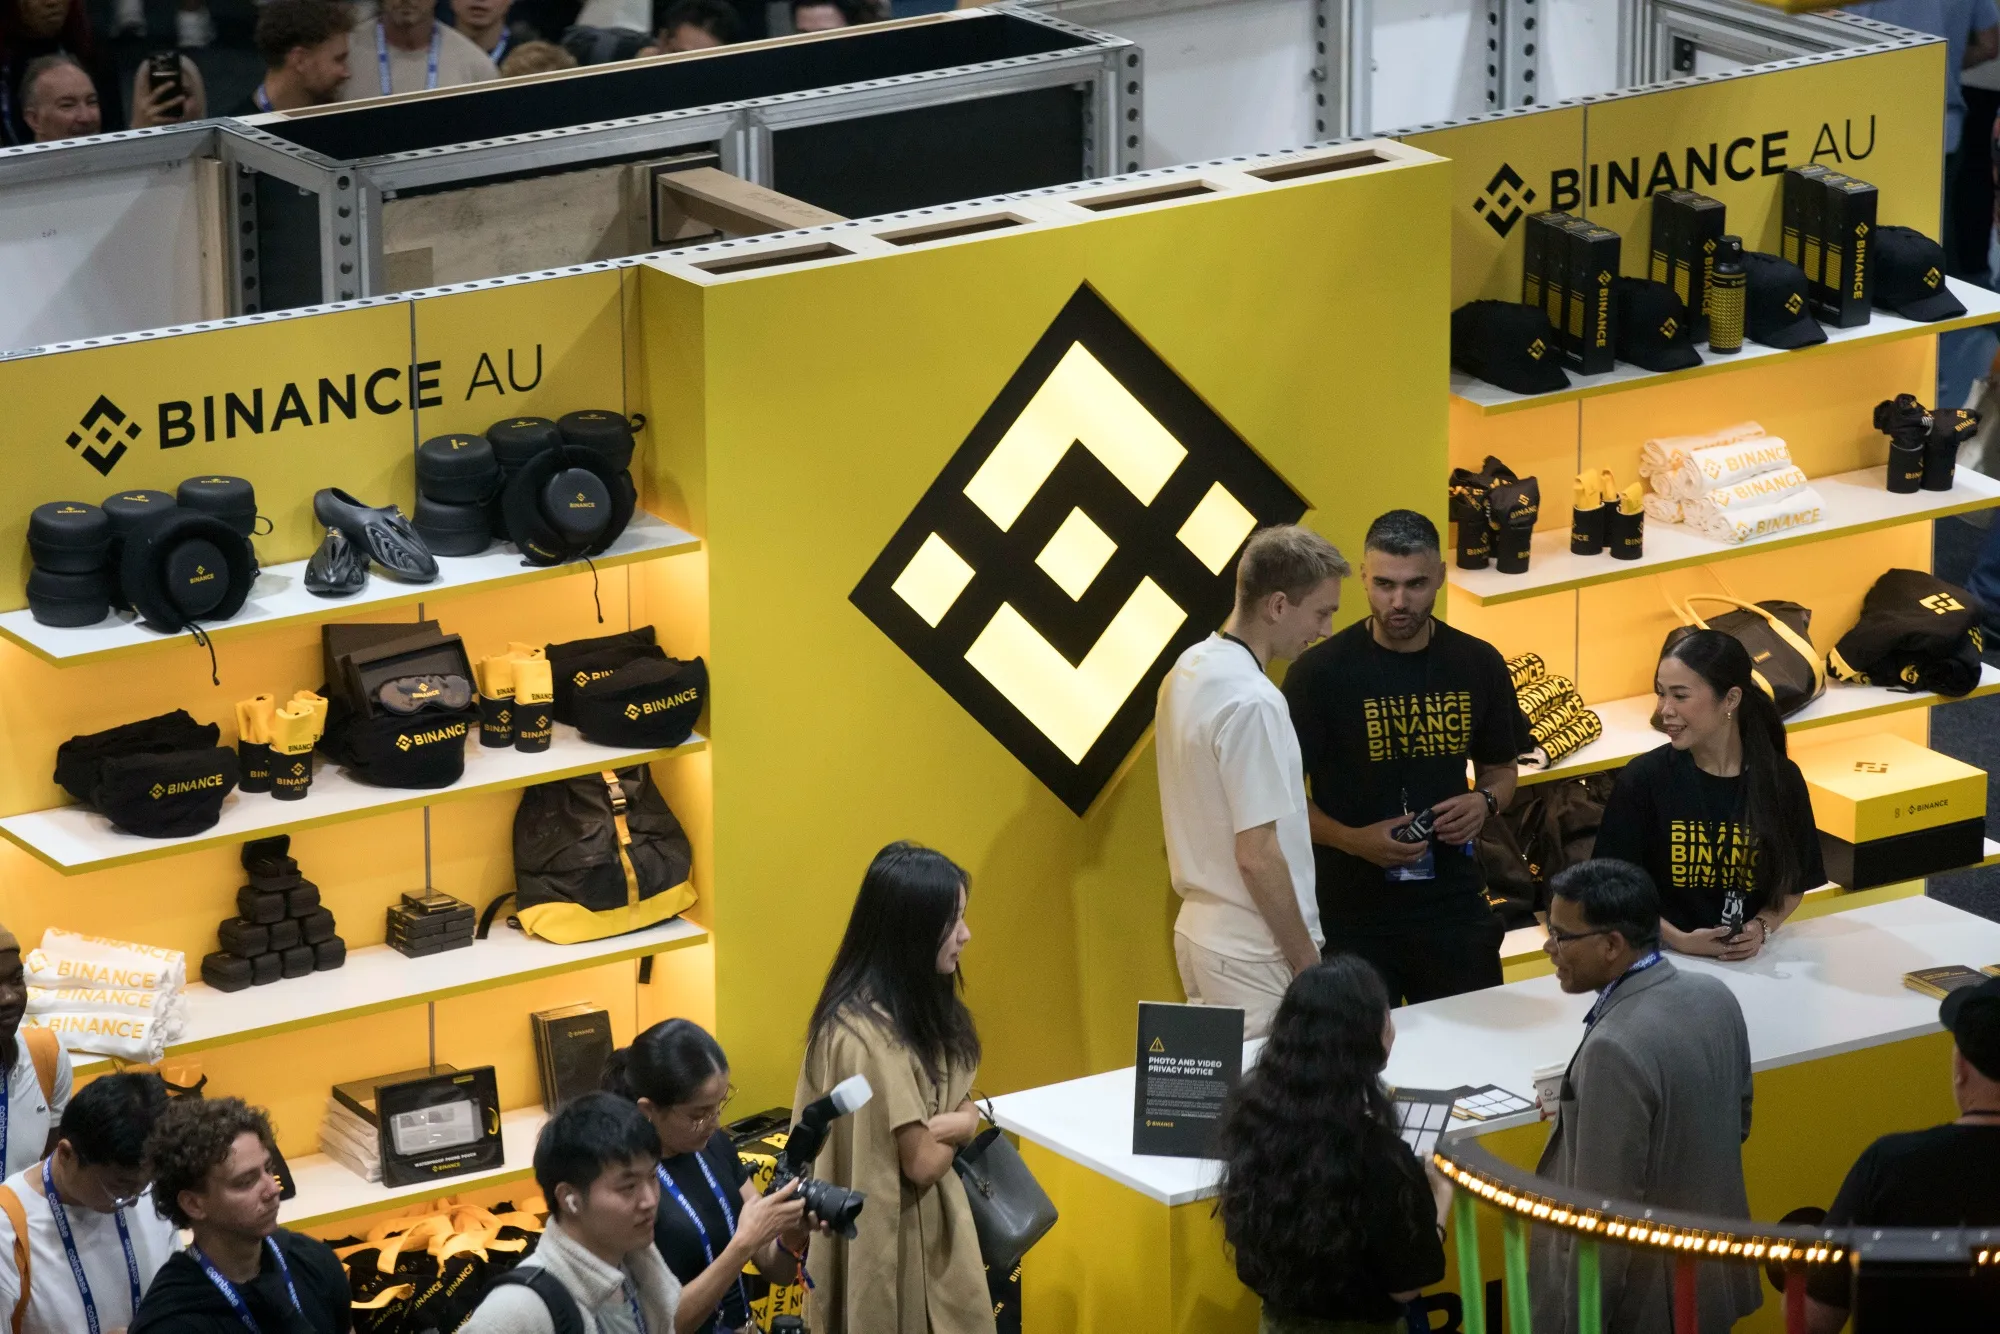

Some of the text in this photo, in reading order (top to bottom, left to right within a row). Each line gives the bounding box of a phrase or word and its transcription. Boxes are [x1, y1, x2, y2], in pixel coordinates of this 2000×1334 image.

[1550, 115, 1876, 212] BINANCE AU
[1854, 240, 1866, 300] BINANCE
[1596, 287, 1609, 348] BINANCE
[157, 344, 543, 450] BINANCE AU
[1734, 470, 1807, 500] BINANCE
[1755, 508, 1821, 535] BINANCE
[189, 573, 214, 584] BINANCE
[412, 688, 440, 700] BINANCE
[643, 687, 698, 716] BINANCE
[1518, 676, 1574, 715] BINANCE
[1367, 713, 1472, 739] BINANCE
[1529, 695, 1584, 742] BINANCE
[413, 722, 467, 747] BINANCE
[1542, 713, 1601, 760] BINANCE
[168, 774, 224, 796] BINANCE
[1917, 799, 1949, 812] BINANCE
[57, 959, 157, 989] BINANCE
[55, 988, 155, 1008] BINANCE
[49, 1016, 145, 1039] BINANCE
[1148, 1056, 1222, 1068] PHOTO AND VIDEO
[1148, 1065, 1214, 1076] PRIVACY NOTICE
[1151, 1120, 1174, 1128] BINANCE
[48, 1192, 69, 1239] coinbase
[67, 1248, 88, 1295] coinbase
[445, 1263, 475, 1298] BINANCE
[206, 1266, 239, 1308] coinbase
